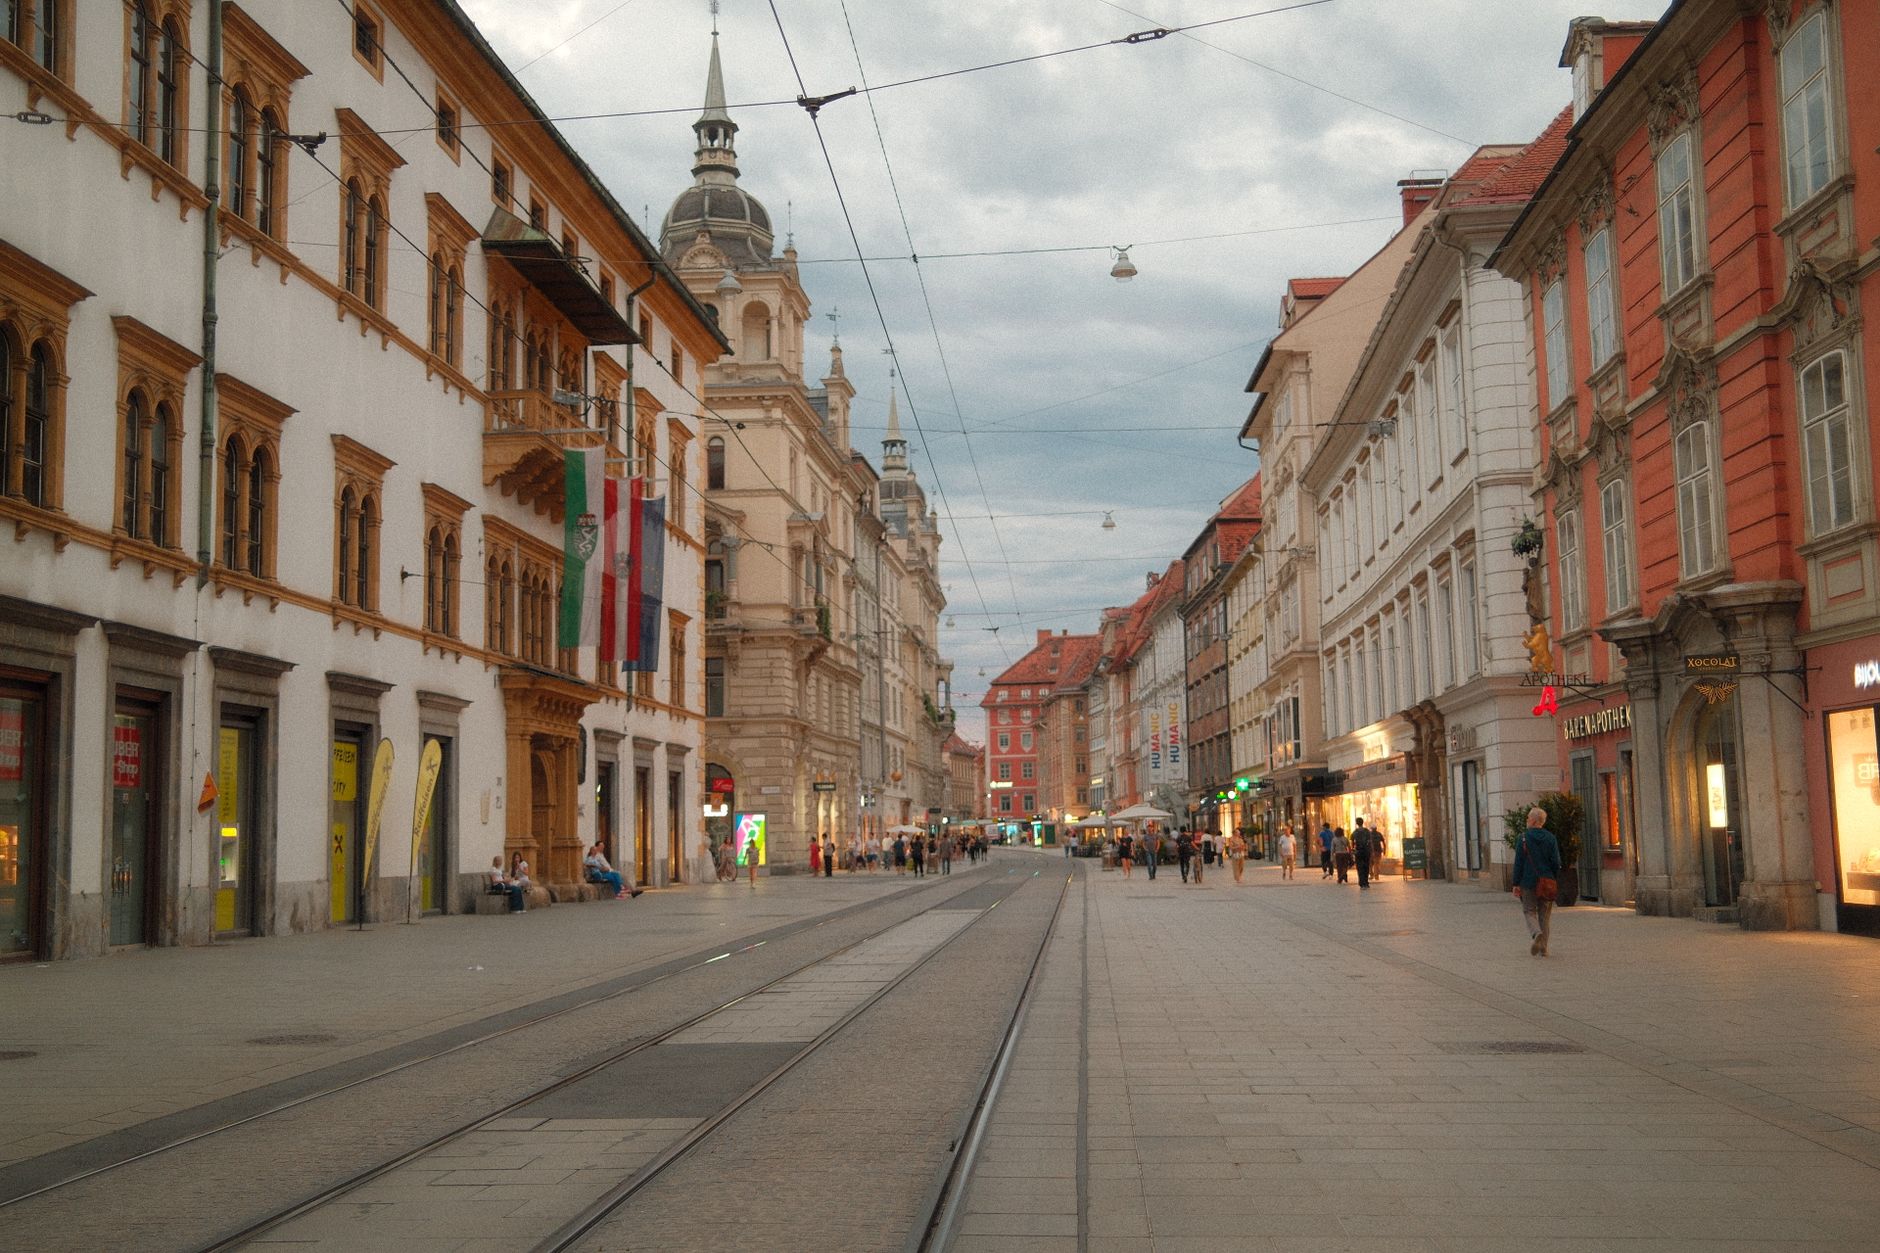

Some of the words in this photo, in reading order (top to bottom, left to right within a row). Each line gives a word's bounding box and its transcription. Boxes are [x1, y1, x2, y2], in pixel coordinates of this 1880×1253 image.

[1519, 672, 1591, 686] APOTHEKE
[1687, 656, 1737, 668] XOCOLAT
[1151, 713, 1161, 769] HUMANIC
[1168, 703, 1180, 763] HUMANIC
[413, 779, 434, 838] Raiffeisen
